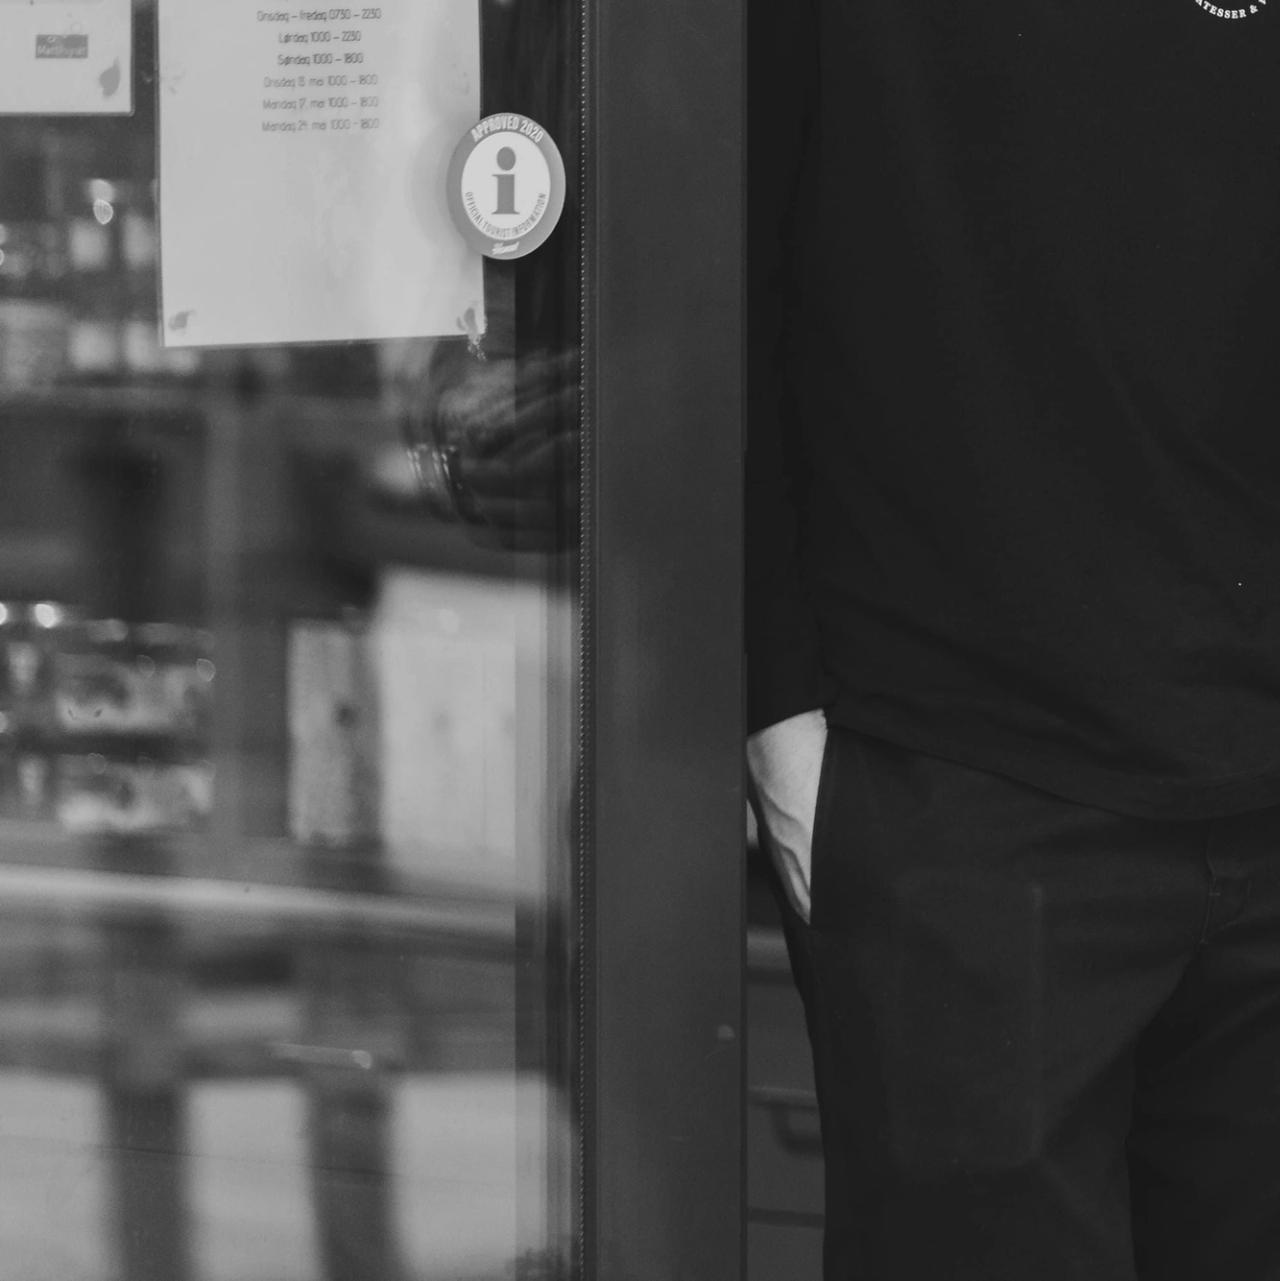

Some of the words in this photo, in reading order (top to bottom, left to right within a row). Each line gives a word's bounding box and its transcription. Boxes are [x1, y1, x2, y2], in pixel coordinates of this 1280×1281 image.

[1249, 4, 1259, 14] &
[471, 115, 519, 142] APPROVED
[520, 121, 544, 143] 2020
